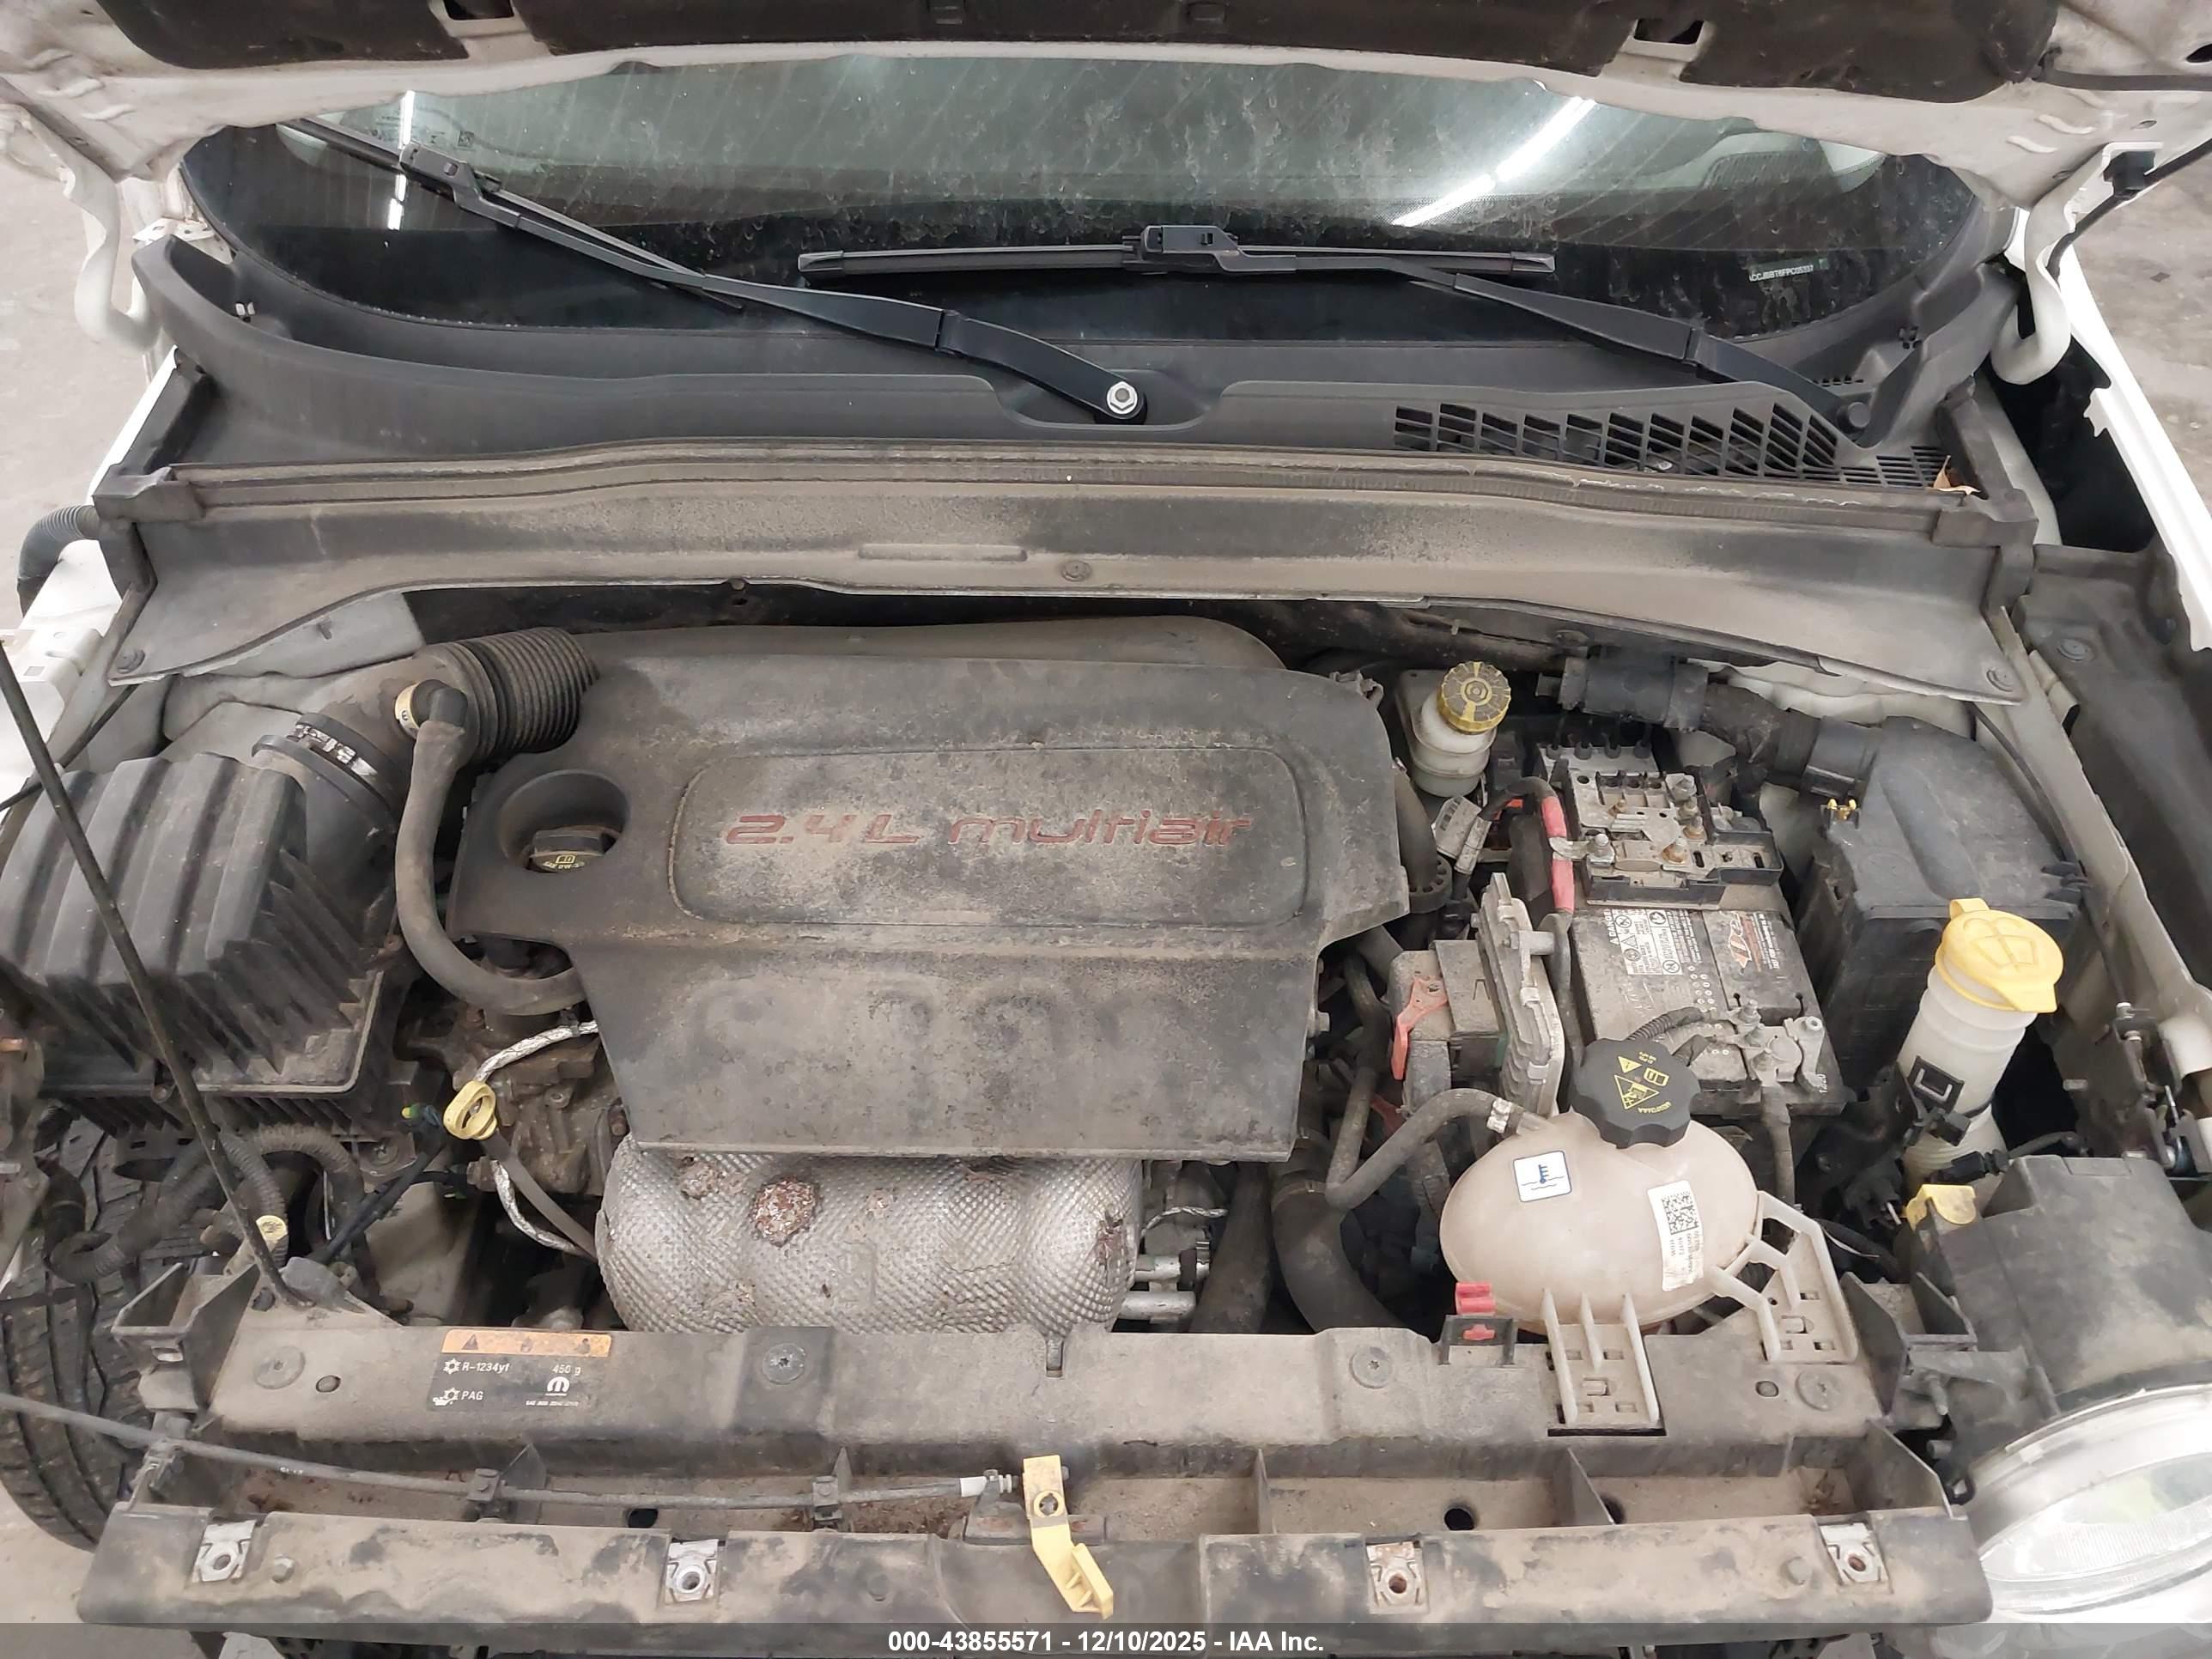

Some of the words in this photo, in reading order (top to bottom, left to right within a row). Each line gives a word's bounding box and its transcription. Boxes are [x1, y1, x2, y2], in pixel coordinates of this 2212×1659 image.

[949, 809, 1252, 846] multiair
[461, 1361, 510, 1374] R-1234yf
[552, 1364, 572, 1374] 450
[574, 1366, 581, 1376] g
[460, 1389, 484, 1401] PAG
